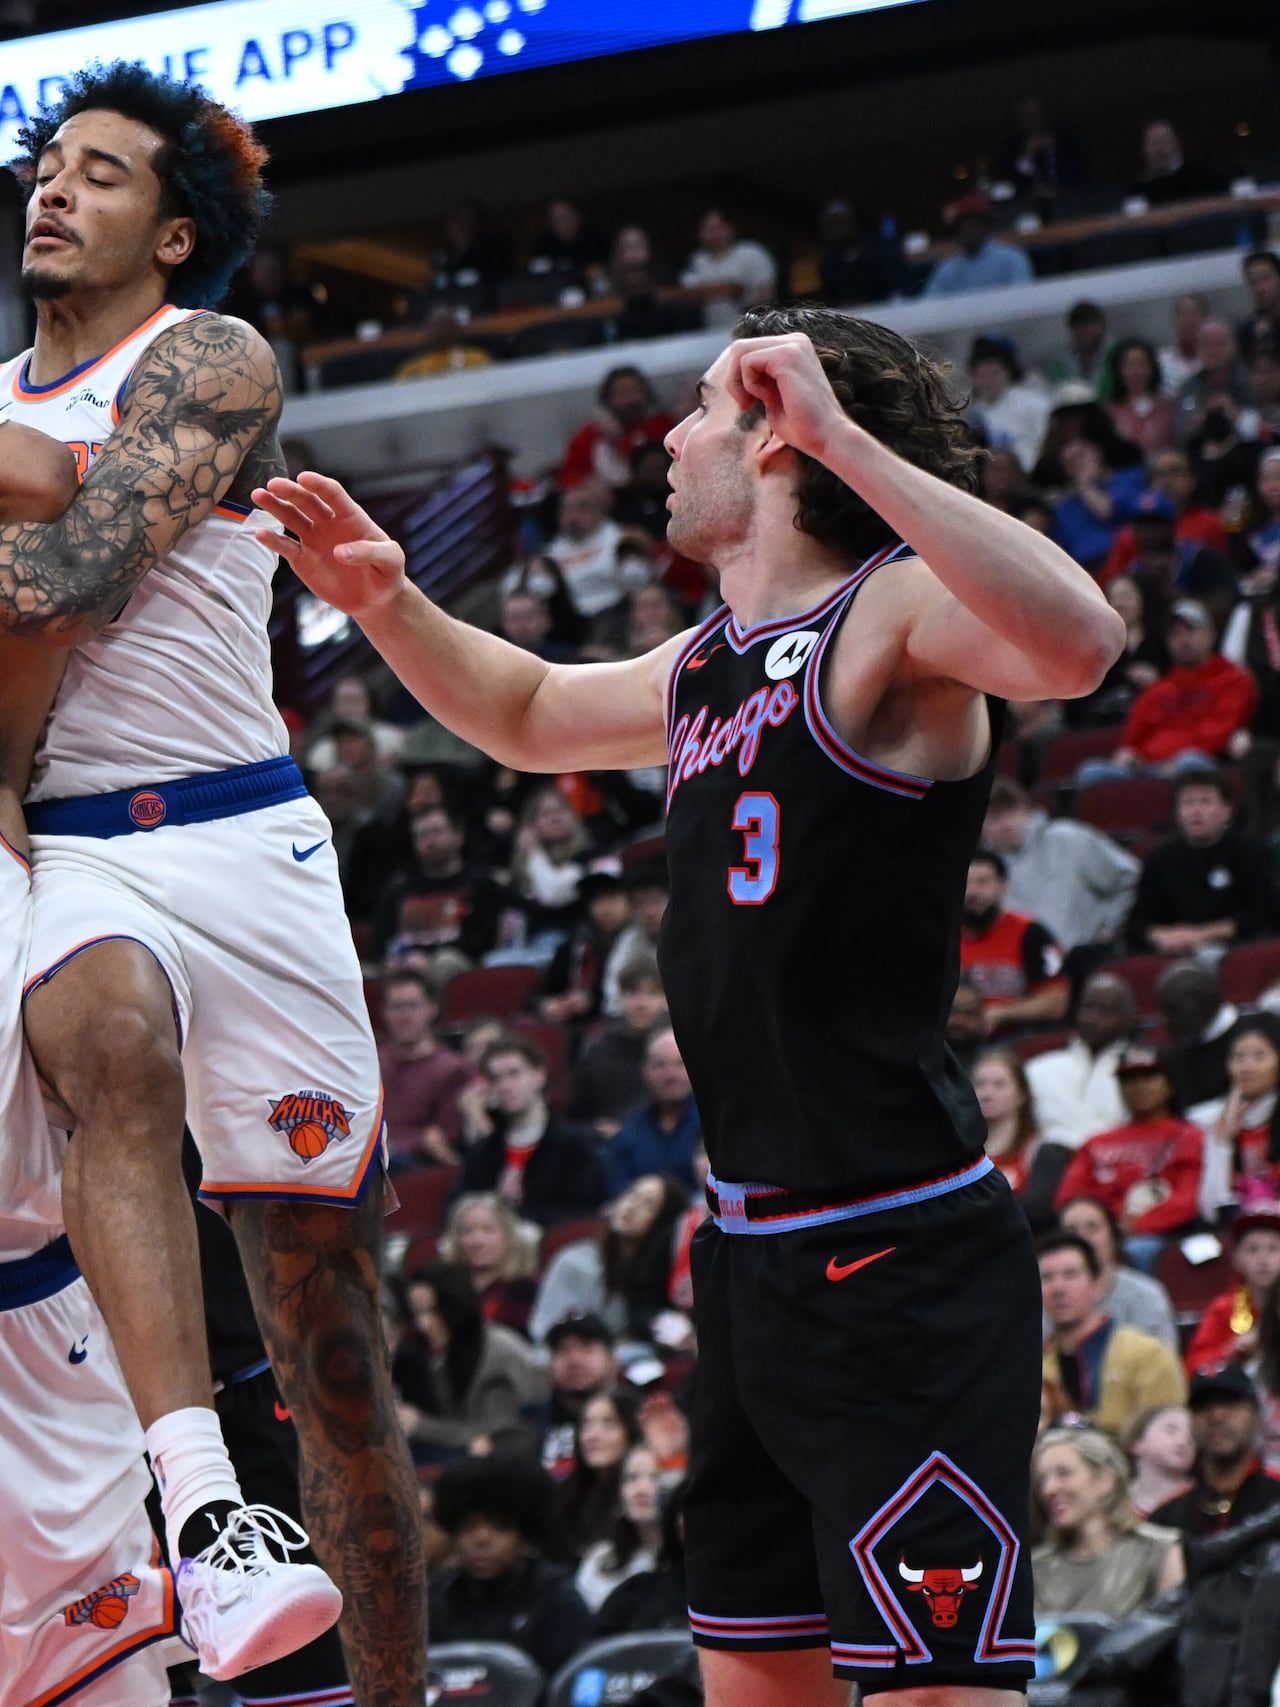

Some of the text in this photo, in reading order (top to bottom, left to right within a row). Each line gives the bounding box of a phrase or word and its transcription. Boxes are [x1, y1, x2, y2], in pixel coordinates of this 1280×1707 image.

[235, 21, 357, 88] APP
[726, 791, 781, 905] 3
[267, 1093, 351, 1136] KNICKS
